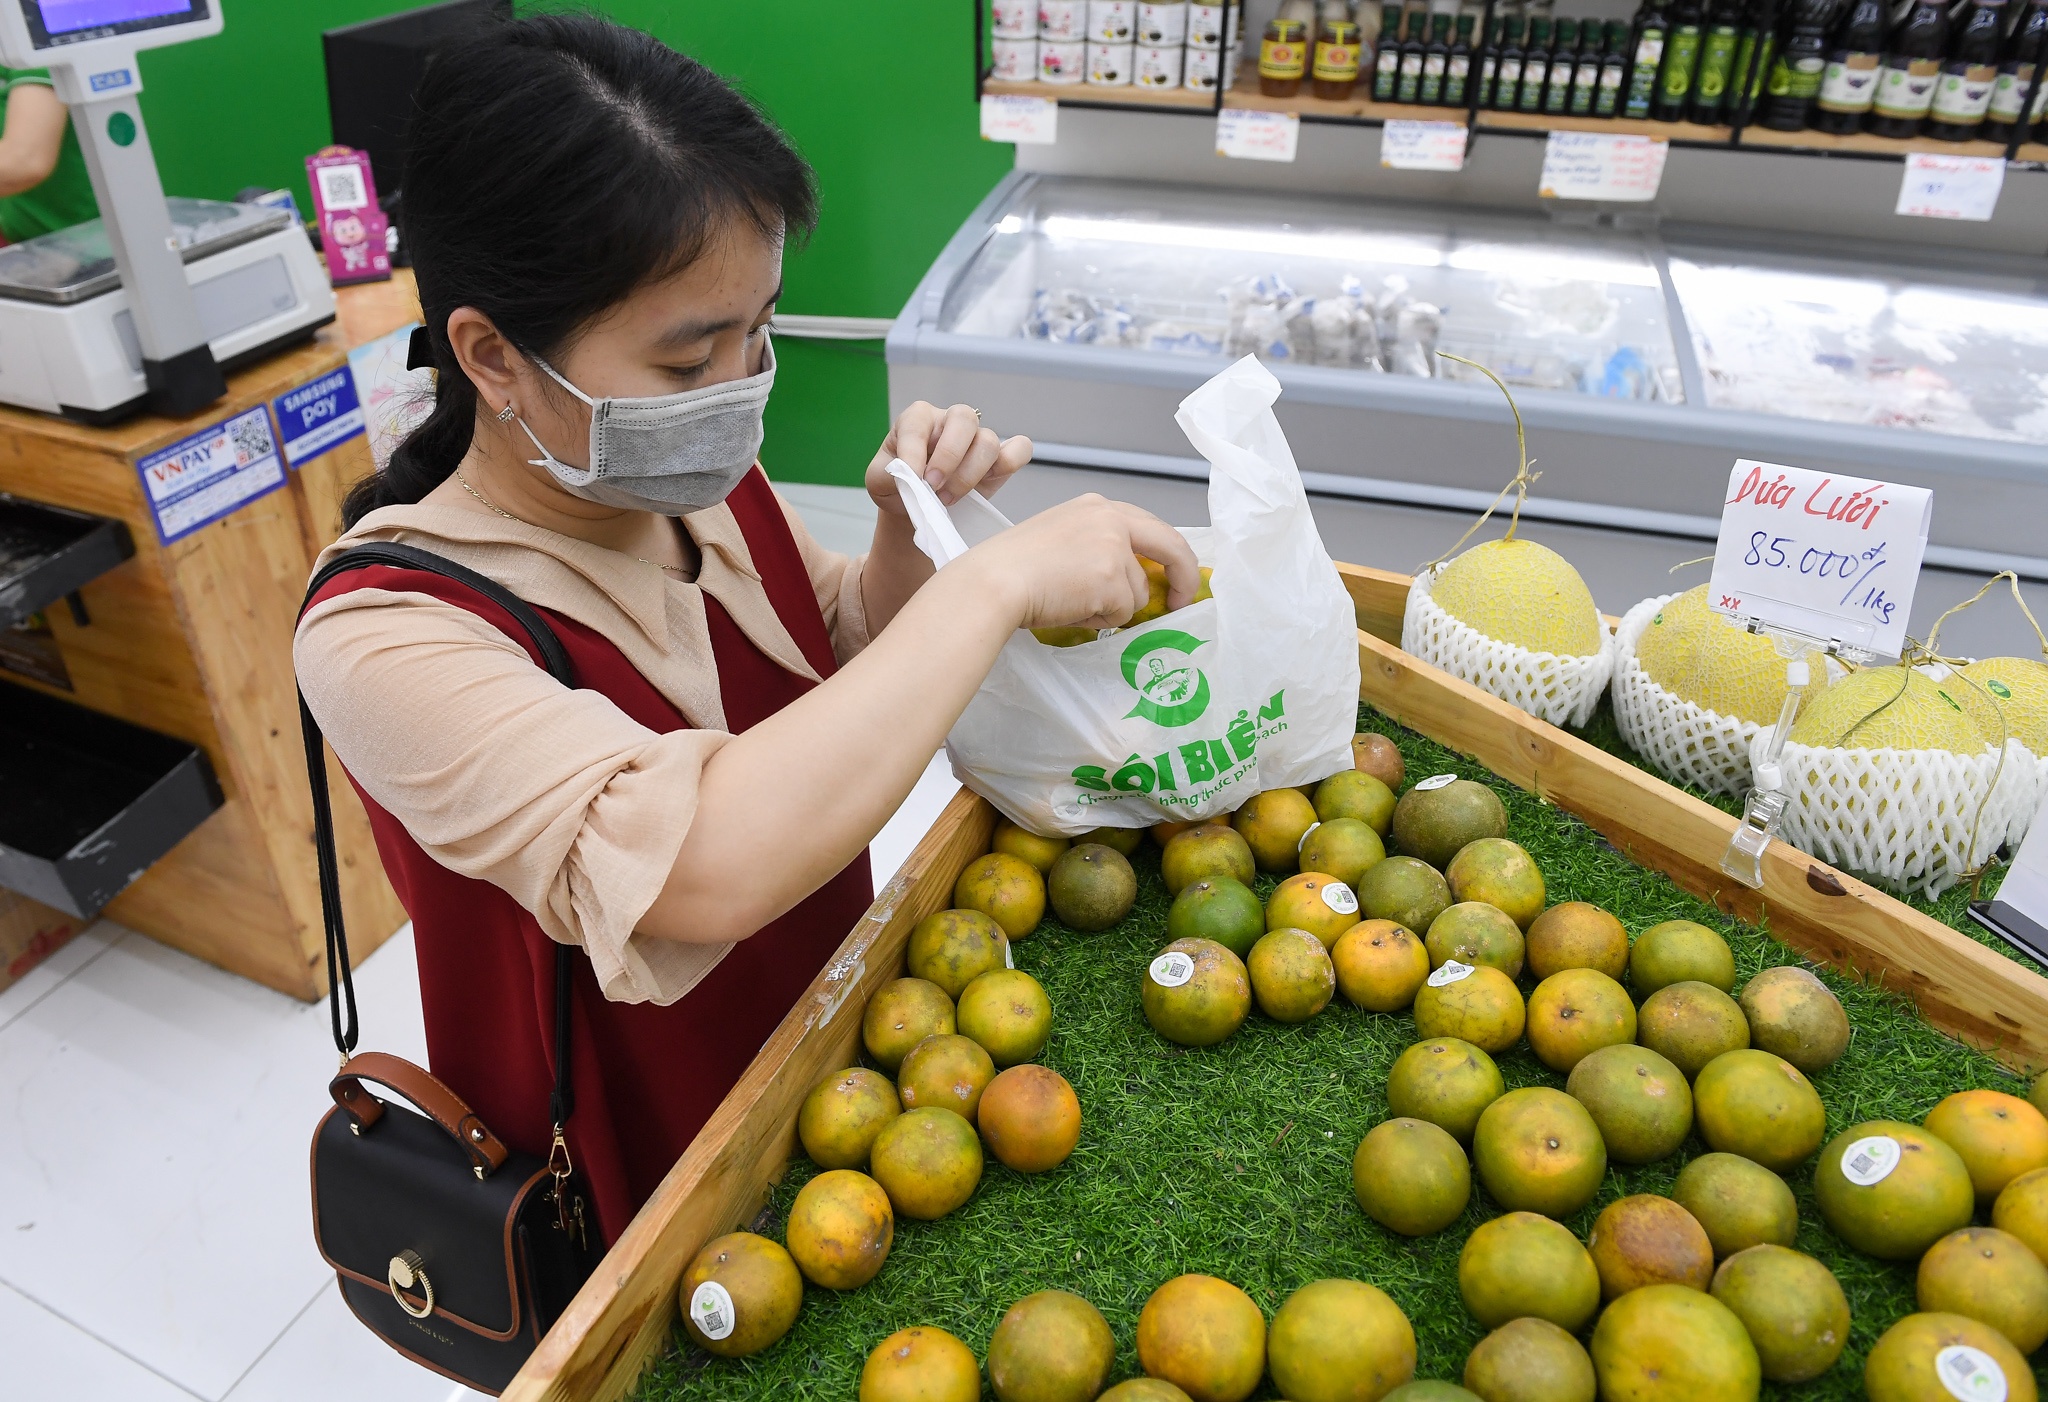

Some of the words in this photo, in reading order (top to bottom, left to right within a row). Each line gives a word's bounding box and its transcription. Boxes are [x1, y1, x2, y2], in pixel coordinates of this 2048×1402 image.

[283, 372, 346, 413] SAMSUNG
[301, 393, 337, 428] pay
[152, 443, 212, 481] VNPAY
